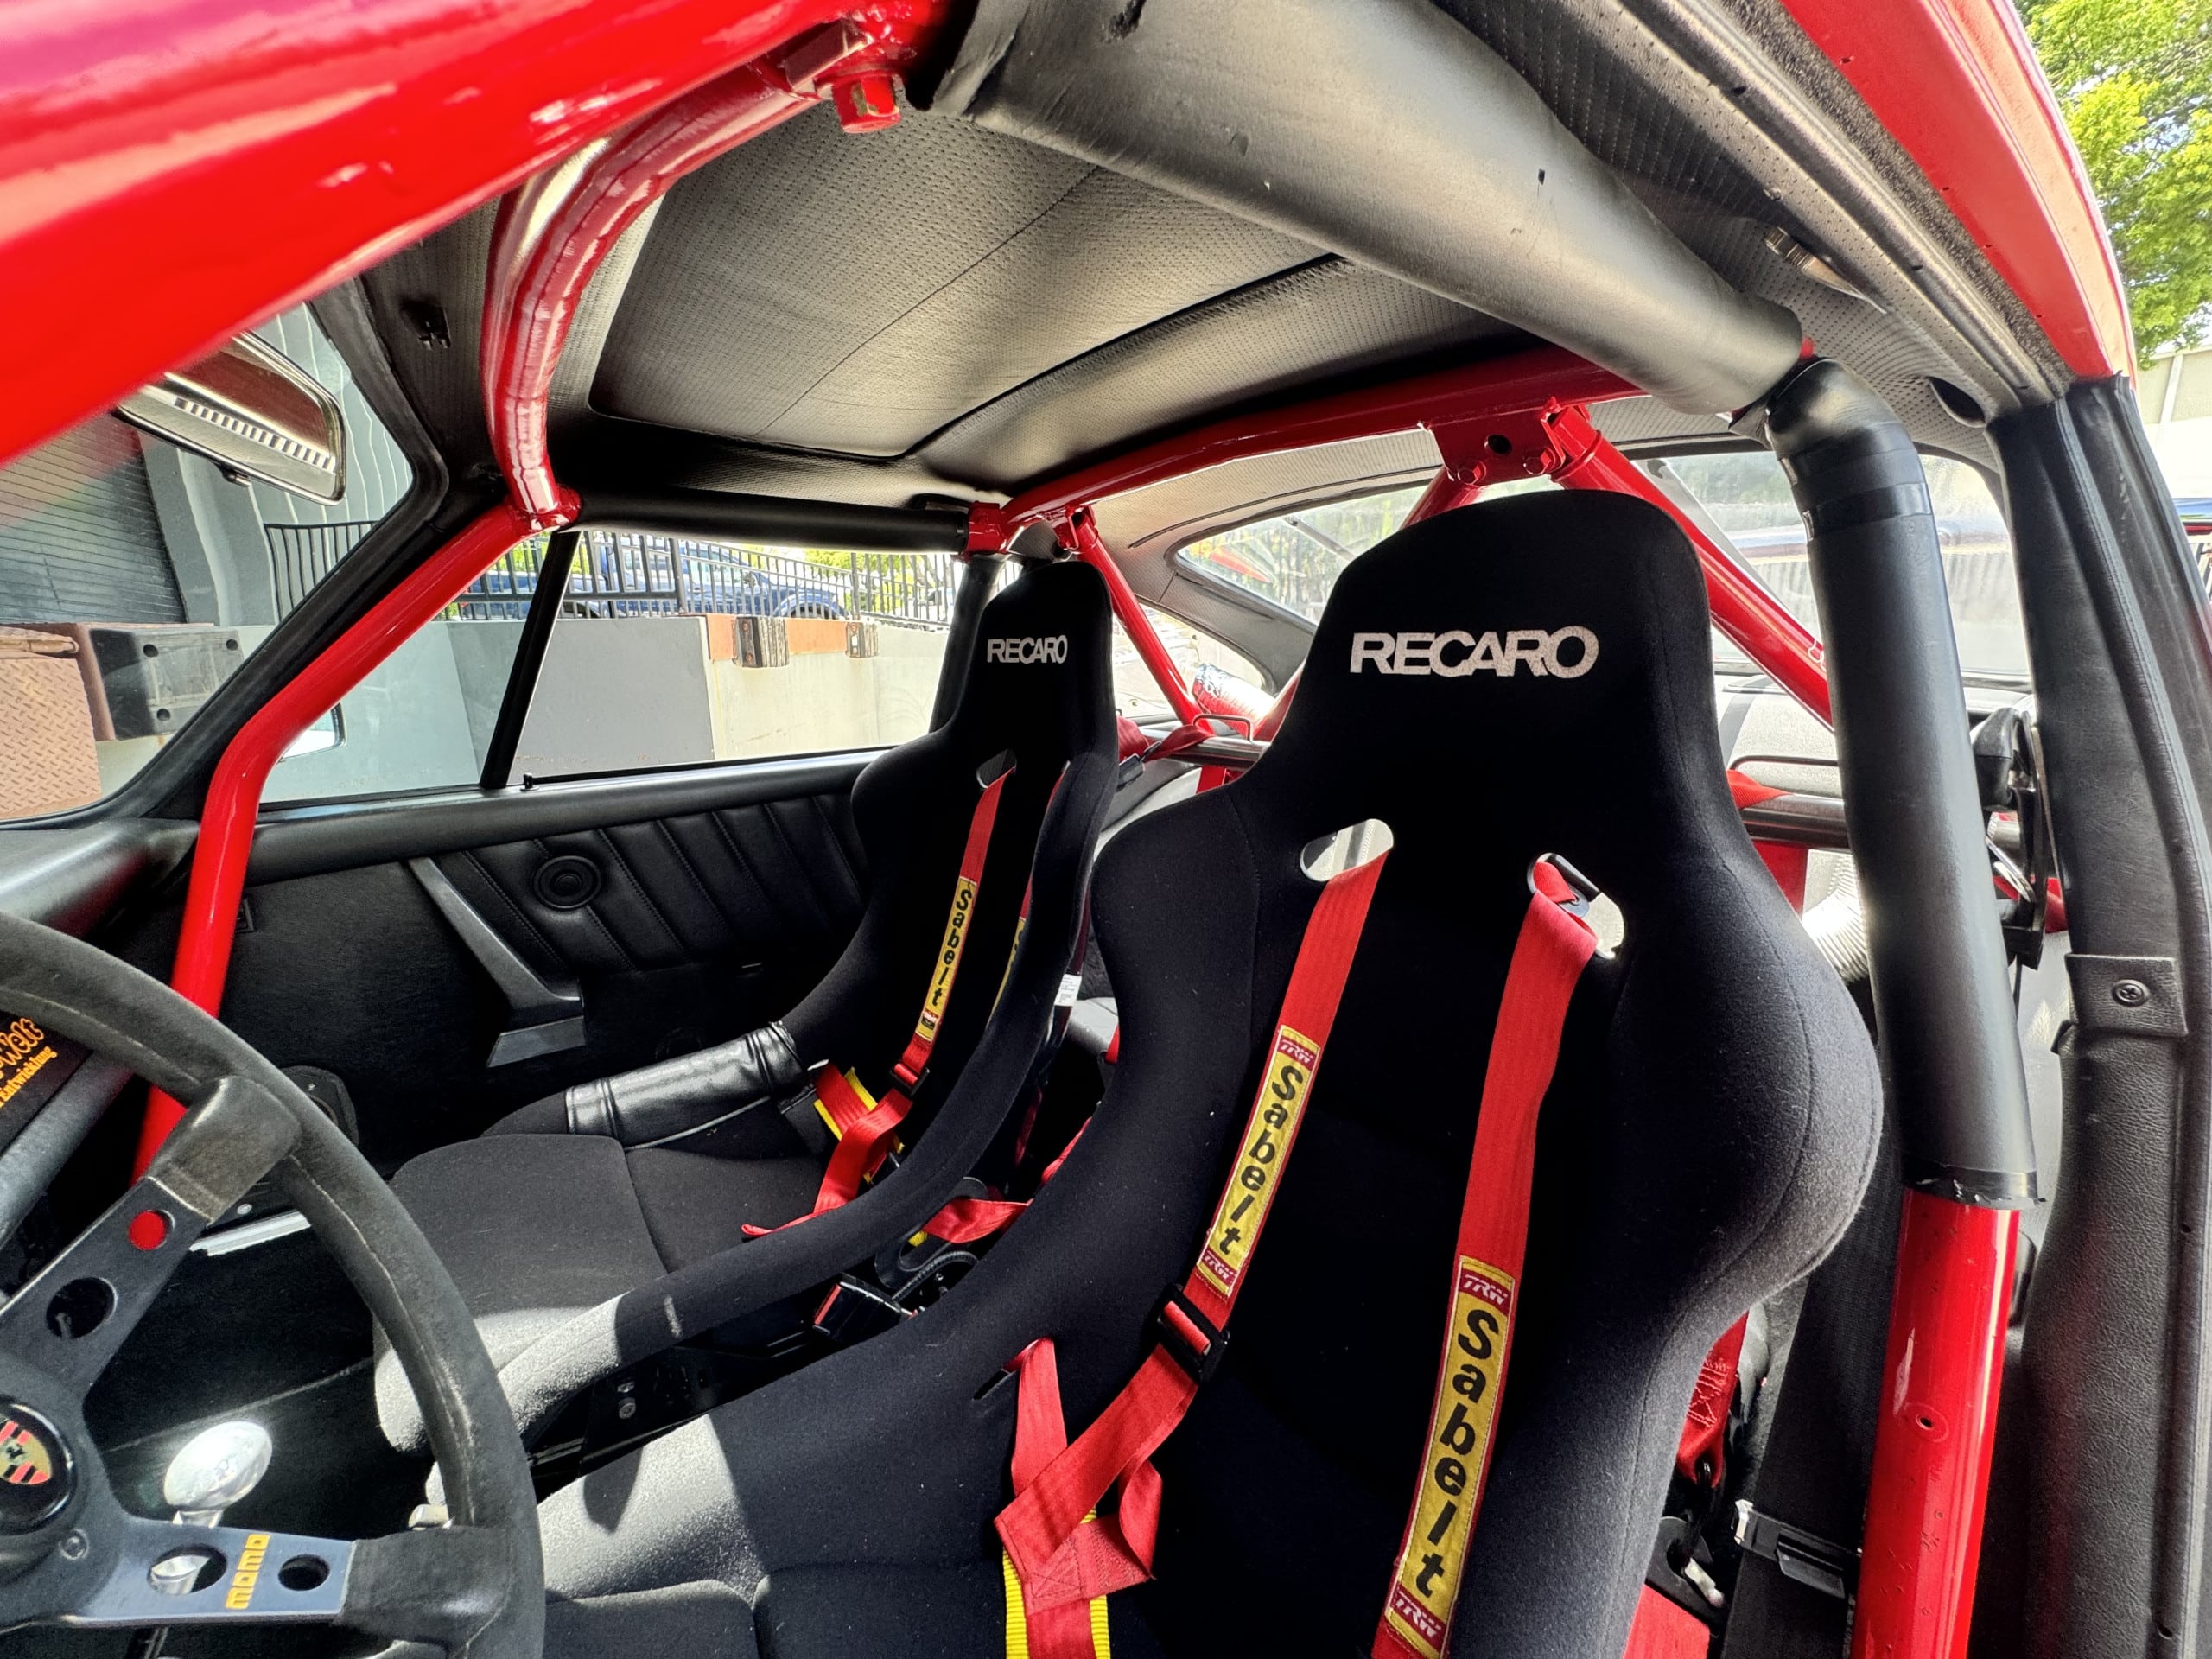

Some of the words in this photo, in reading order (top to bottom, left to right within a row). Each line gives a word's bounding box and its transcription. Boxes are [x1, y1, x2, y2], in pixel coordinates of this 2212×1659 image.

[987, 635, 1068, 664] RECARO
[1350, 626, 1599, 678] RECARO
[932, 889, 972, 1007] Sabelt
[1280, 1039, 1313, 1065] TRW
[1219, 1065, 1304, 1255] Sabelt
[1204, 1250, 1236, 1281] TRW
[1462, 1274, 1510, 1306] TRW
[1415, 1308, 1499, 1598] Sabelt
[1395, 1593, 1442, 1639] TRW
